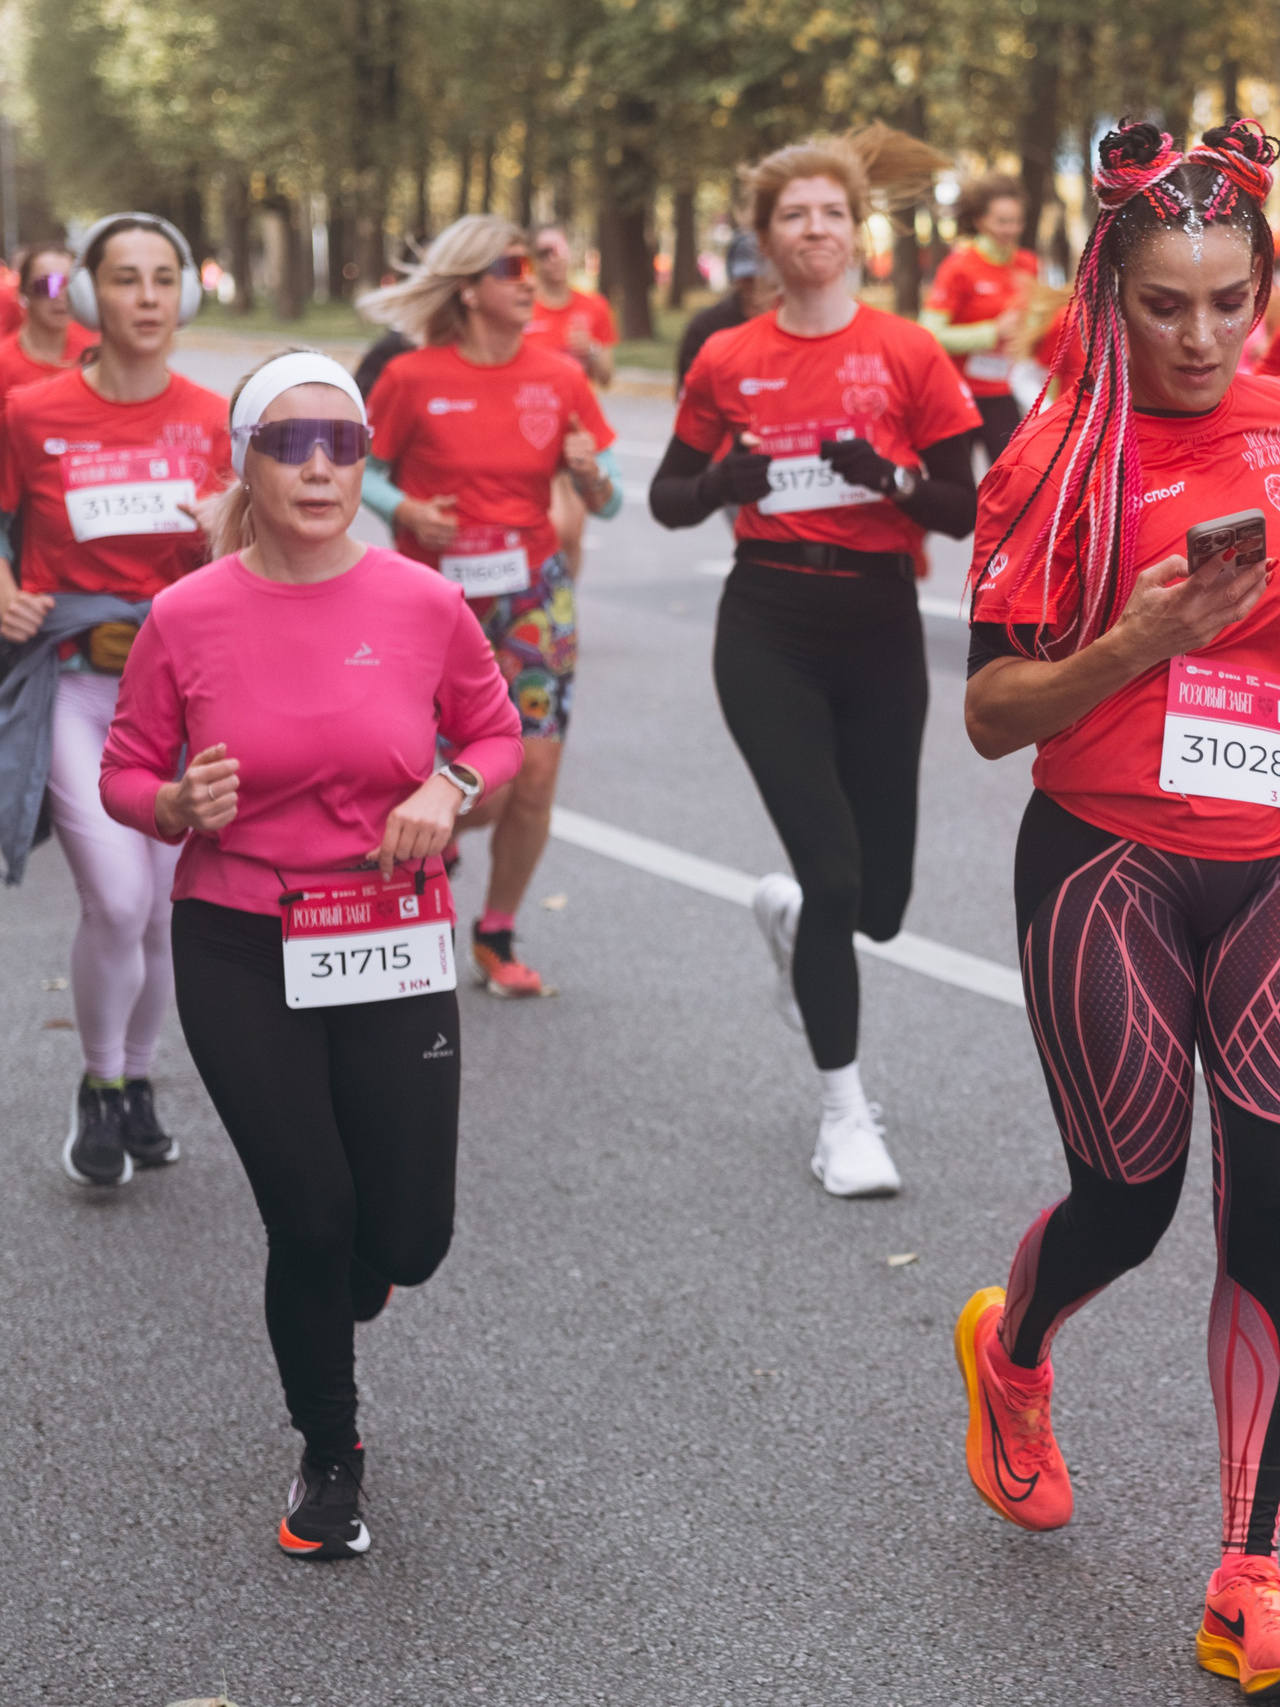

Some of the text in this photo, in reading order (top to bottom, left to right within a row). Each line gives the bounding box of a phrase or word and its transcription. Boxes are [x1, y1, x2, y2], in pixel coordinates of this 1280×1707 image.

[772, 466, 835, 492] 3175
[1143, 481, 1186, 504] спорт
[83, 494, 165, 520] 31353
[1178, 682, 1254, 715] РОЗОВЫЙ ЗАБЕГ
[1270, 790, 1278, 802] 3
[293, 901, 372, 929] РОЗОВЫЙ ЗАБЕГ
[311, 943, 412, 978] 31715
[399, 981, 406, 993] 3
